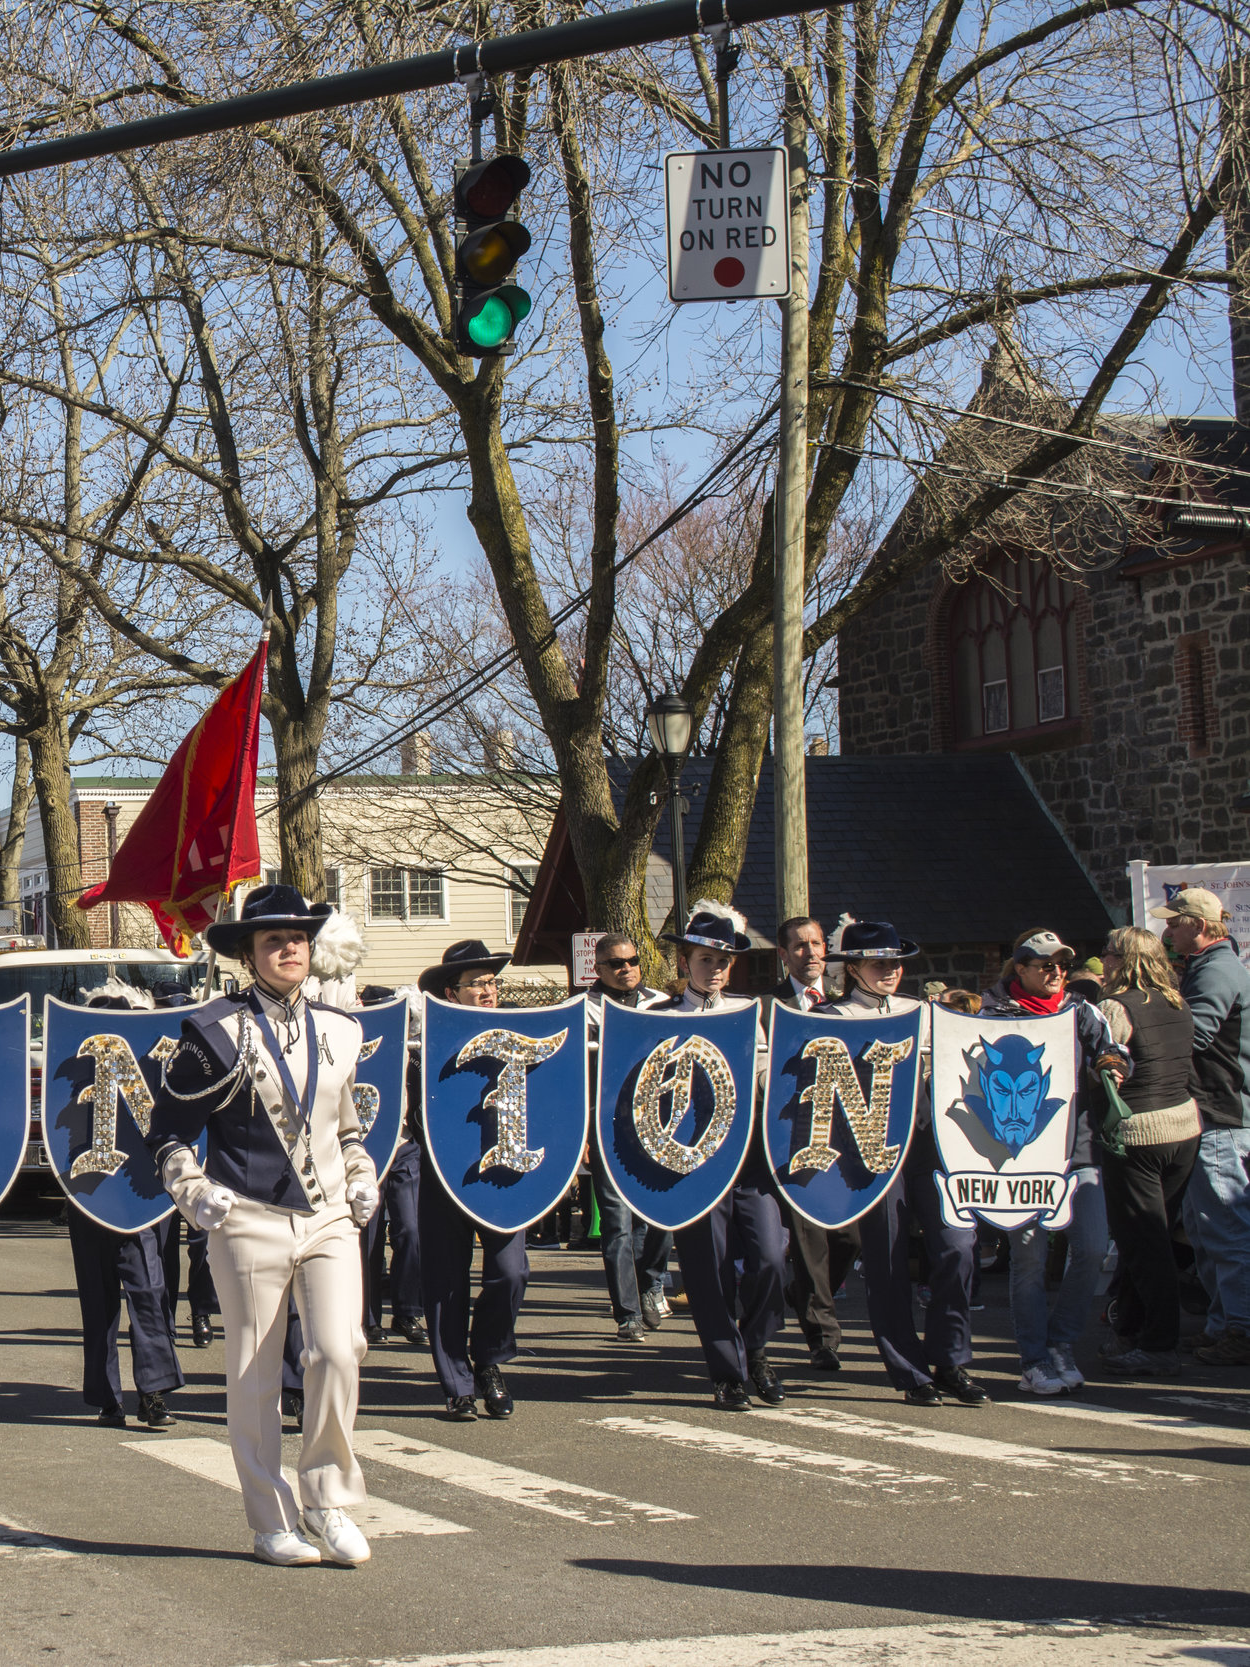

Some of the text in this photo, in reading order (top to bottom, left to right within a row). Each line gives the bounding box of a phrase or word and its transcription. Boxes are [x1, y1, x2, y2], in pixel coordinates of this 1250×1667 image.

[700, 161, 752, 189] NO
[692, 195, 763, 221] TURN
[679, 225, 777, 252] ON RED
[583, 938, 597, 948] NO
[956, 1178, 1056, 1206] NEW YORK
